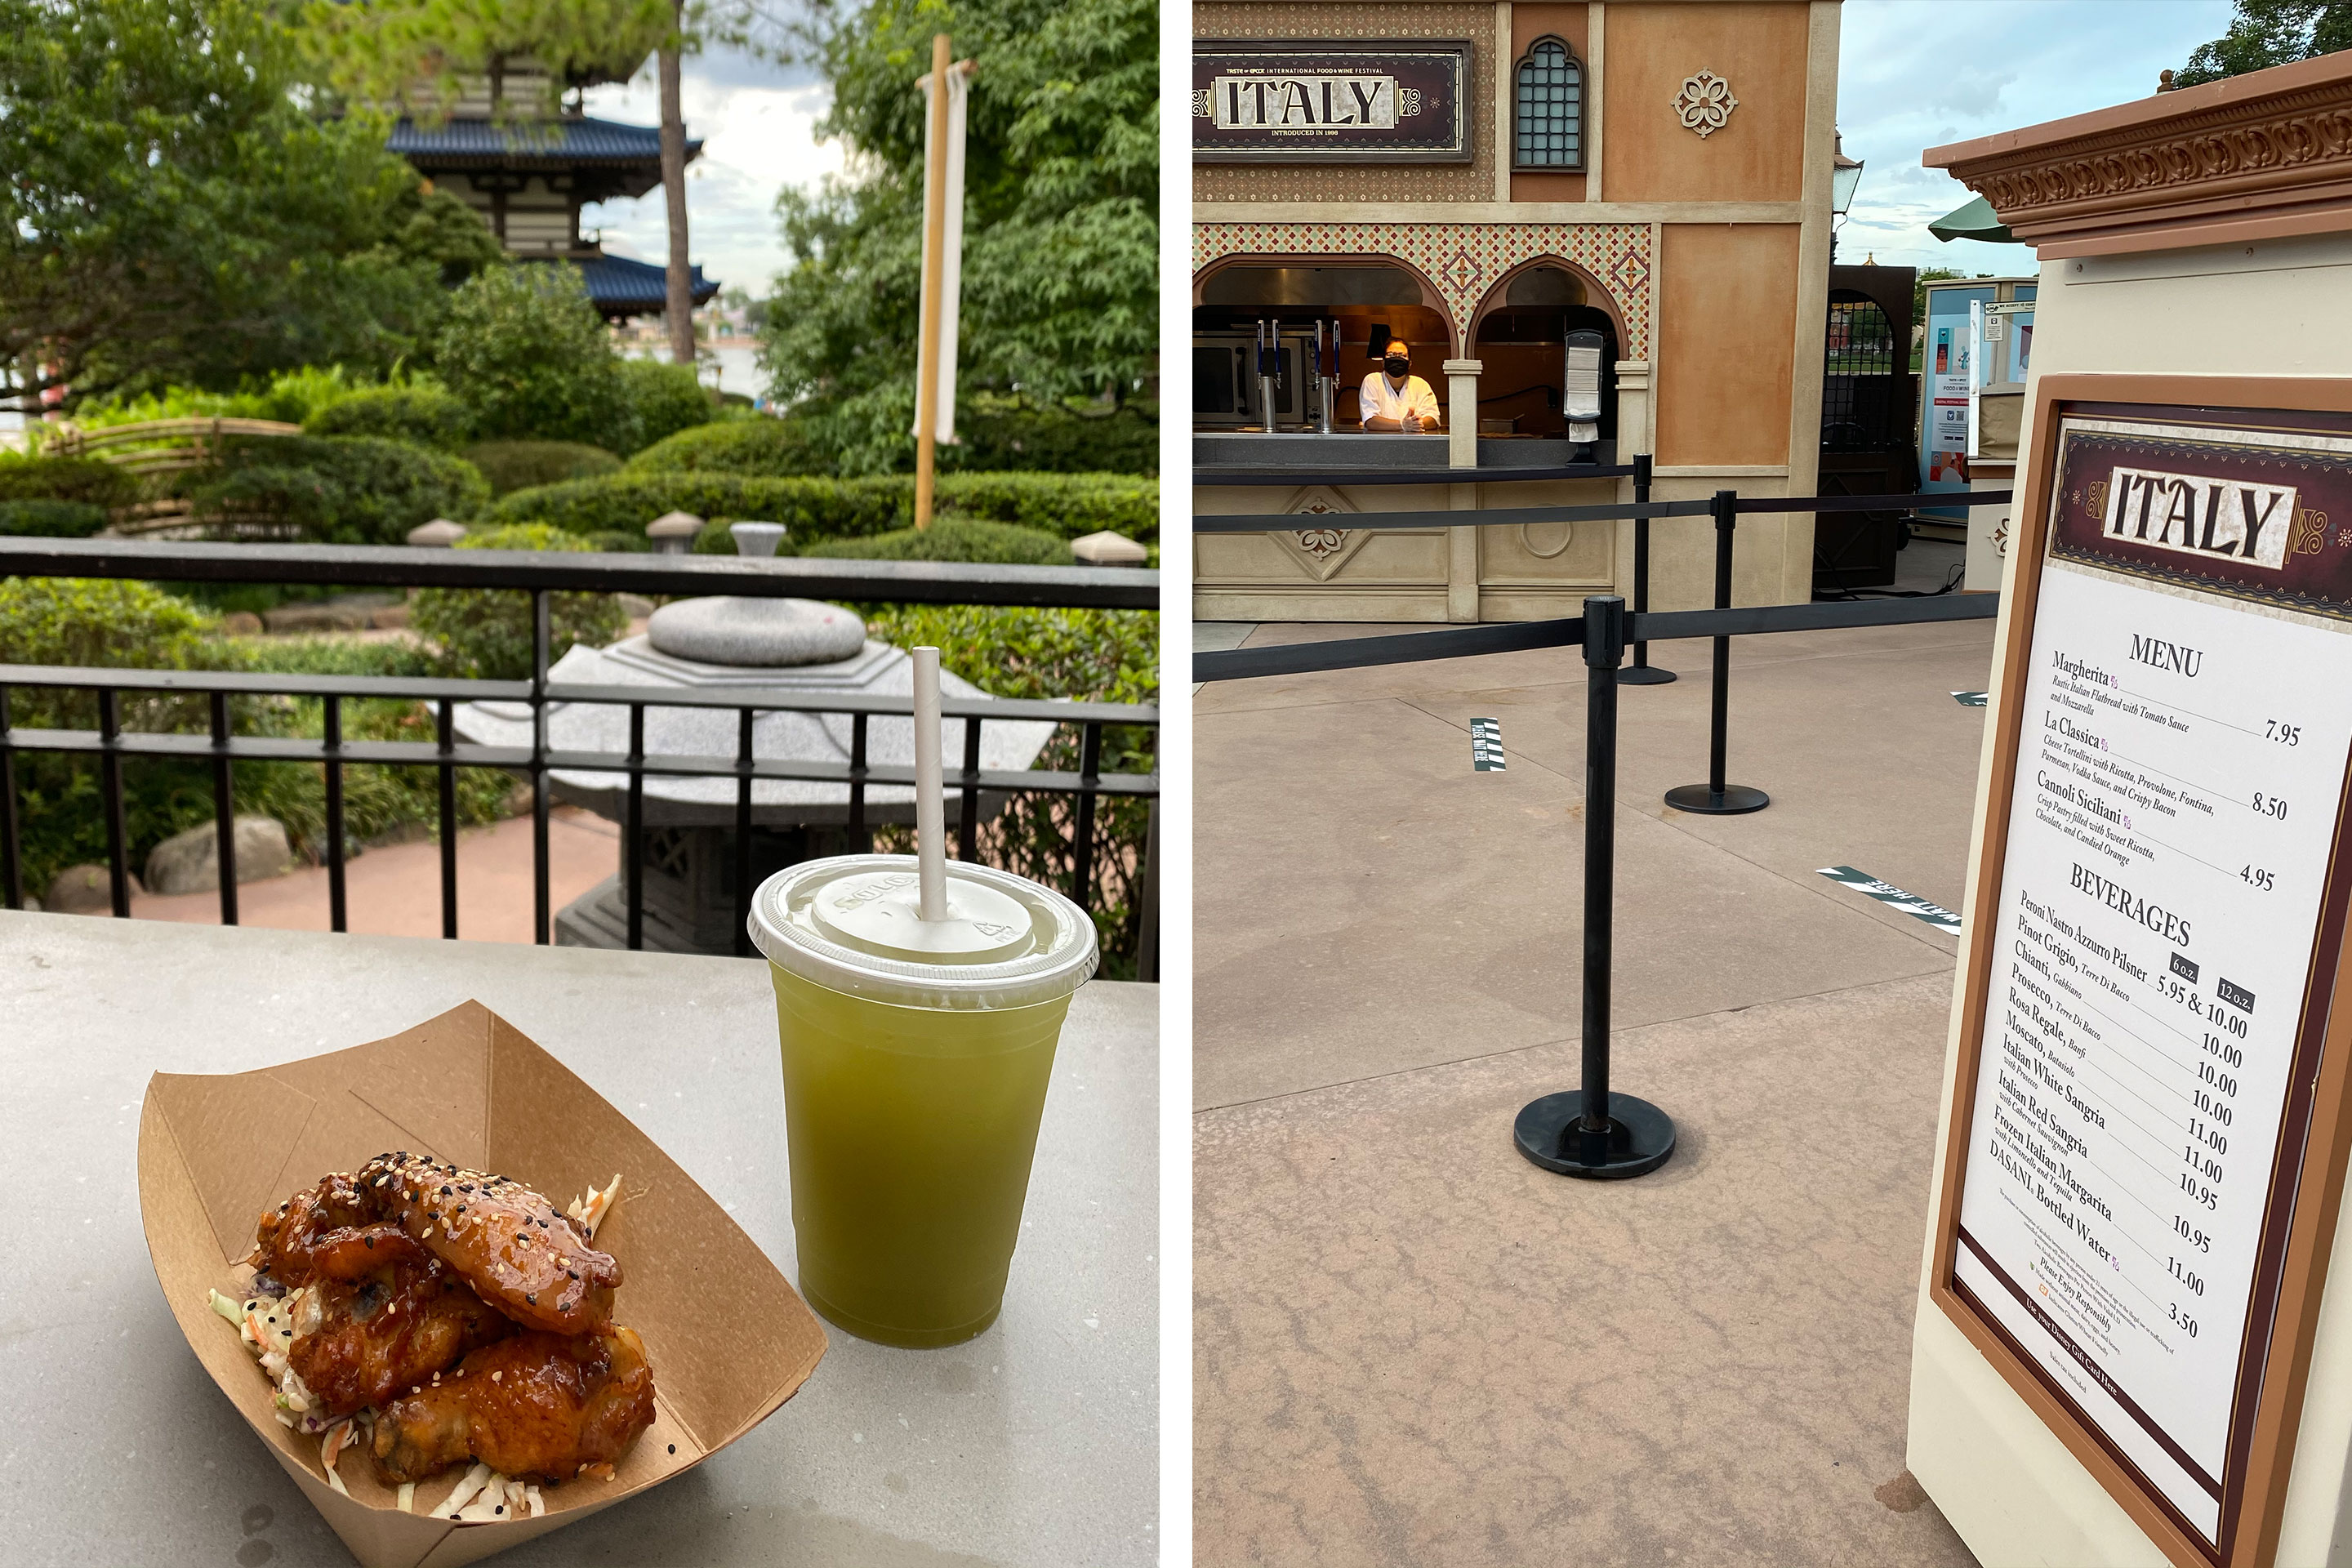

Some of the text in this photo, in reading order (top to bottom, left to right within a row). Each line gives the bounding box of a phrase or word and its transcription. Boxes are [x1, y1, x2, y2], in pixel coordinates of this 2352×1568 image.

[1225, 79, 1384, 126] ITALY
[2112, 473, 2285, 560] ITALY
[2051, 650, 2301, 746] Margherita 7.95
[2128, 633, 2203, 678] MENU
[2050, 693, 2095, 716] and Mozzarella
[2051, 674, 2189, 733] Rustic Italian Flatbread with Tomato Sauce
[2041, 748, 2176, 817] Parmesan, Vodka Sauce, and Crispy Bacon
[2043, 733, 2214, 817] Cheese Tortellini with Ricotta, Provolone, Fontina,
[2044, 710, 2287, 821] La Classica 8.50
[2034, 807, 2130, 867] Chocolate, and Candied Orange
[2037, 792, 2154, 862] Crisp Pastry filled with Sweet Ricotta,
[2037, 769, 2275, 892] Cannoli Siciliani 4.95
[833, 875, 915, 911] SOLO
[1865, 880, 1962, 923] WAIT HERE
[2069, 862, 2190, 947] BEVERAGES
[2017, 913, 2242, 1068] Pinot Grigio, Terre Di Bacco 10.00
[2020, 889, 2247, 1039] Peroni Nastro Azzurro Pilsner 5.95 & 10.00
[2172, 958, 2252, 1011] 6 o.z. 12 o.z.
[2011, 961, 2232, 1127] Prosecco, Terre Di Bacco 10.00
[2015, 939, 2237, 1098] Chianti, Gabbiano 10.00
[2003, 1056, 2038, 1089] with Prosecco
[2005, 1009, 2222, 1183] Moscato, Batasiolo 11.00
[2008, 985, 2227, 1155] Rosa Regale, Banfi 11.00
[1998, 1091, 2069, 1157] with Cabernet Sauvignon
[1998, 1068, 2211, 1254] Italian Red Sangria 10.95
[2002, 1032, 2218, 1210] Italian White Sangria 10.95
[1993, 1103, 2024, 1145] Frozen
[2025, 1132, 2056, 1174] Italian
[2057, 1161, 2112, 1222] Margarita
[2167, 1256, 2204, 1297] 11.00
[1994, 1126, 2073, 1202] with Limoncello and Tequila
[2035, 1183, 2074, 1230] Bottled
[2076, 1218, 2110, 1263] Water
[2167, 1302, 2198, 1339] 3.50
[2039, 1256, 2058, 1280] Please
[2057, 1273, 2075, 1298] Enjoy
[2075, 1290, 2111, 1333] Responsibly
[2026, 1297, 2117, 1396] Use your Disney Gift Card Here
